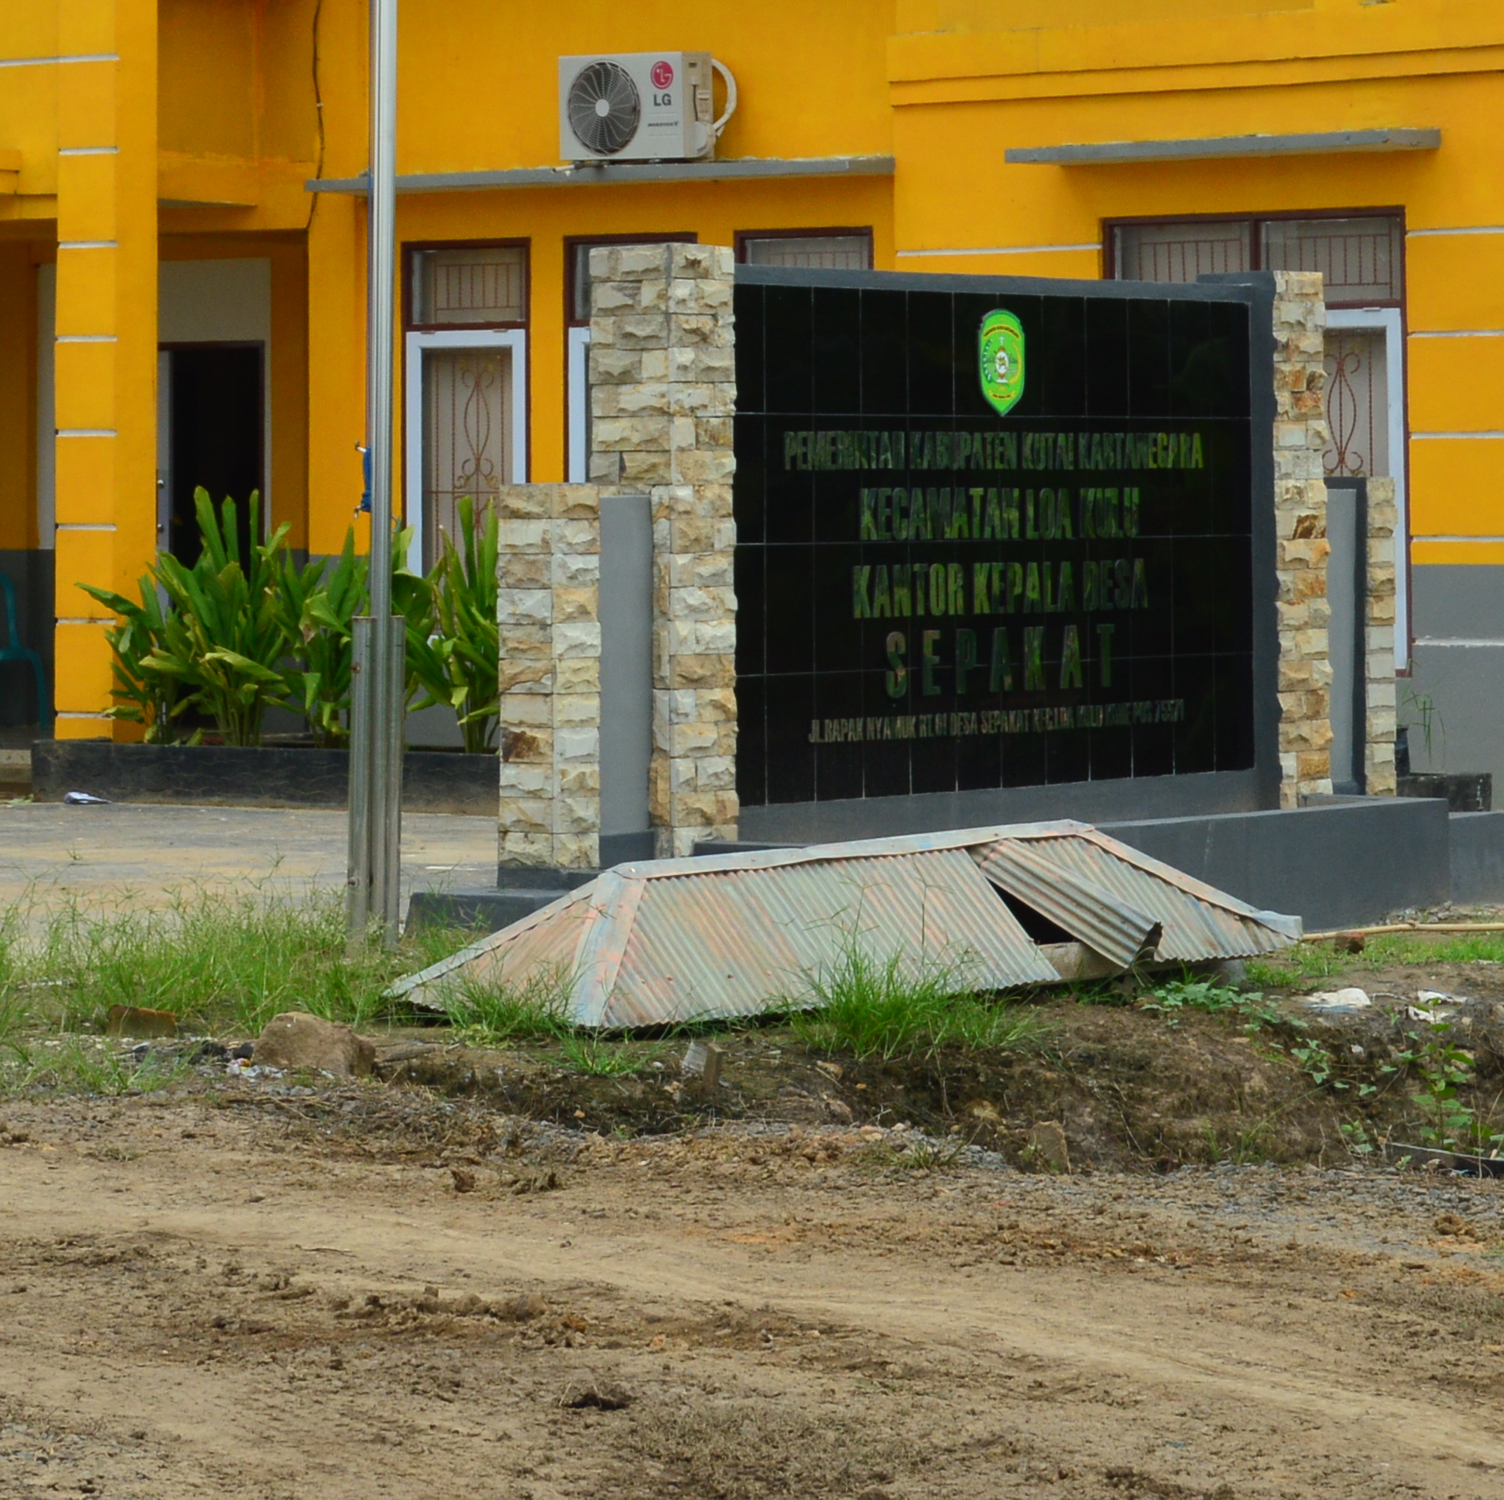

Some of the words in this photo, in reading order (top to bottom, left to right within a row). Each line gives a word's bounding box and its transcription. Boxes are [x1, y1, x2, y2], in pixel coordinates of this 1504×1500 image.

[653, 93, 672, 107] LG
[783, 431, 906, 471] PEMERINTAH
[909, 431, 1018, 470] KABUPATEN
[1021, 432, 1075, 470] KUTAI
[1078, 432, 1204, 470] KARTANEGARA
[859, 486, 1020, 541] KECAMATAN
[1025, 487, 1074, 540] LOA
[1079, 486, 1140, 539] KULU
[852, 562, 965, 619] KANTOR
[973, 560, 1076, 615] KEPALA
[1082, 557, 1149, 612] DESA
[885, 623, 1115, 700] SEPAKAT
[865, 714, 917, 741] NYAMUK
[949, 711, 979, 737] DESA
[980, 709, 1031, 734] SEPAKAT
